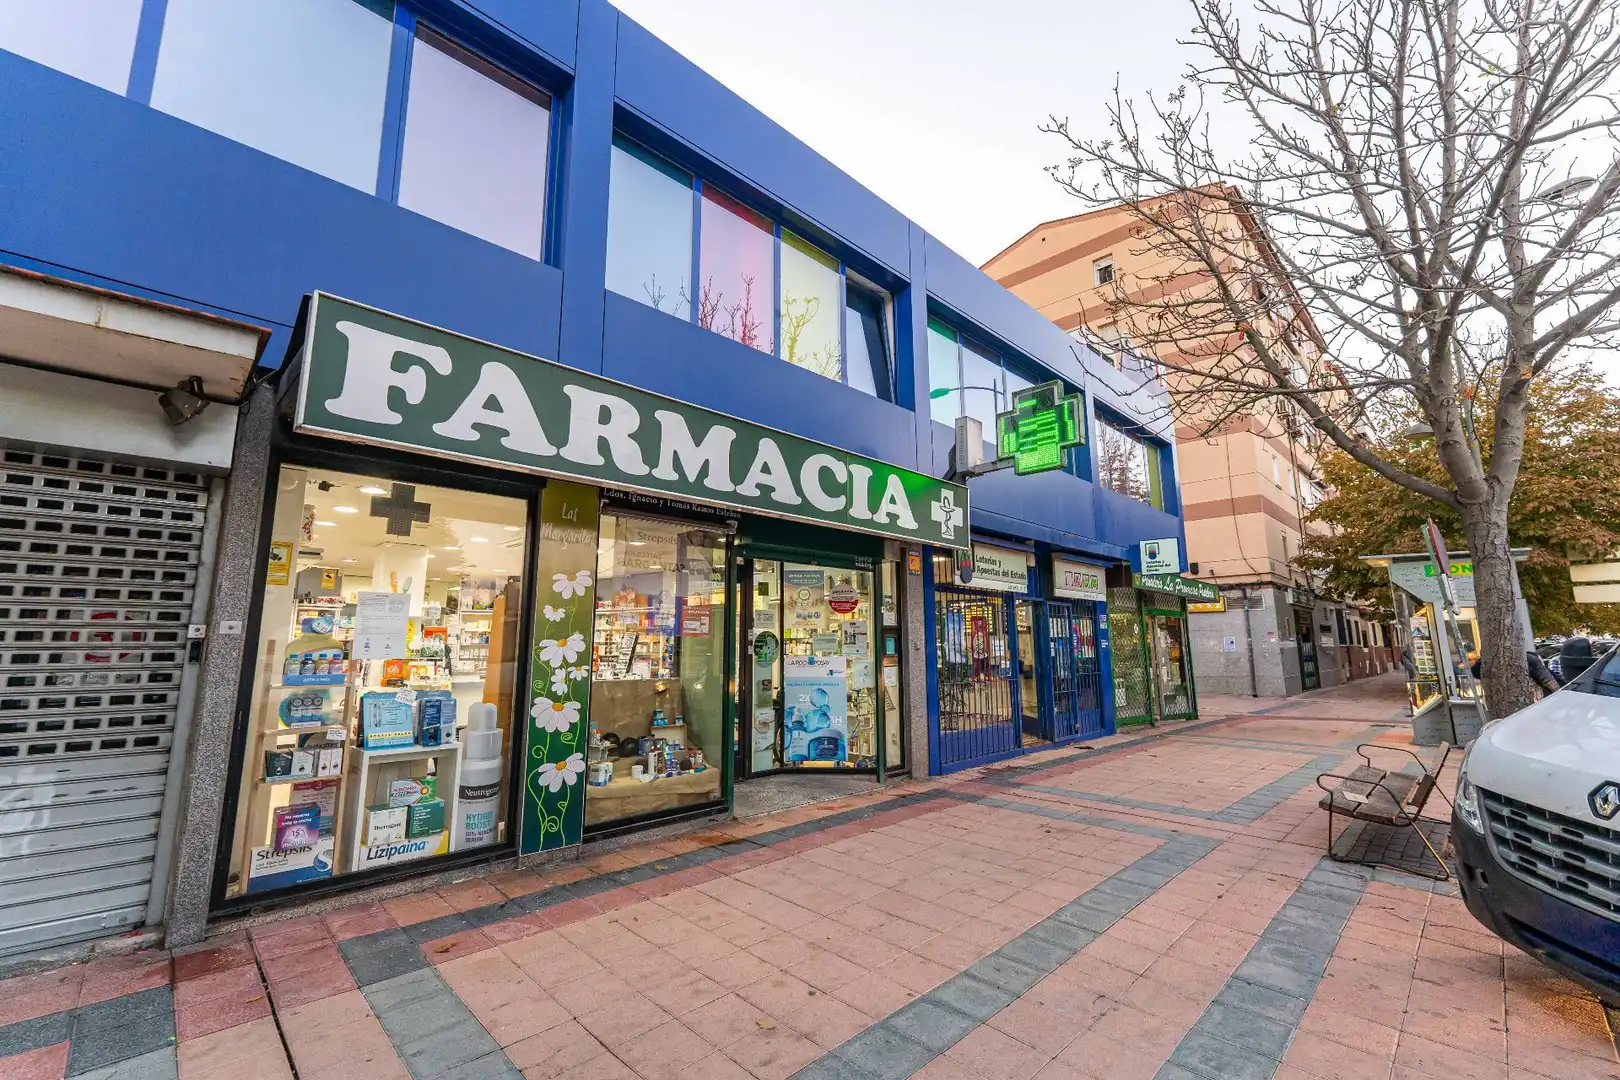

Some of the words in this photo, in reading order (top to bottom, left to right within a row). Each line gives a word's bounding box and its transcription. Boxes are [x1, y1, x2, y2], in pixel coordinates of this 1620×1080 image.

[324, 320, 919, 530] FARMACIA
[603, 487, 626, 499] Ldos.
[628, 492, 658, 504] Ignacio
[561, 502, 579, 522] Las
[541, 520, 596, 550] Margaritas
[636, 531, 677, 545] Strepsils
[975, 554, 998, 566] Loterías
[976, 565, 1001, 577] Apuestas
[1001, 569, 1010, 577] del
[1010, 570, 1027, 580] Estado
[256, 845, 312, 861] Strepsils
[366, 840, 427, 861] Lizipaina
